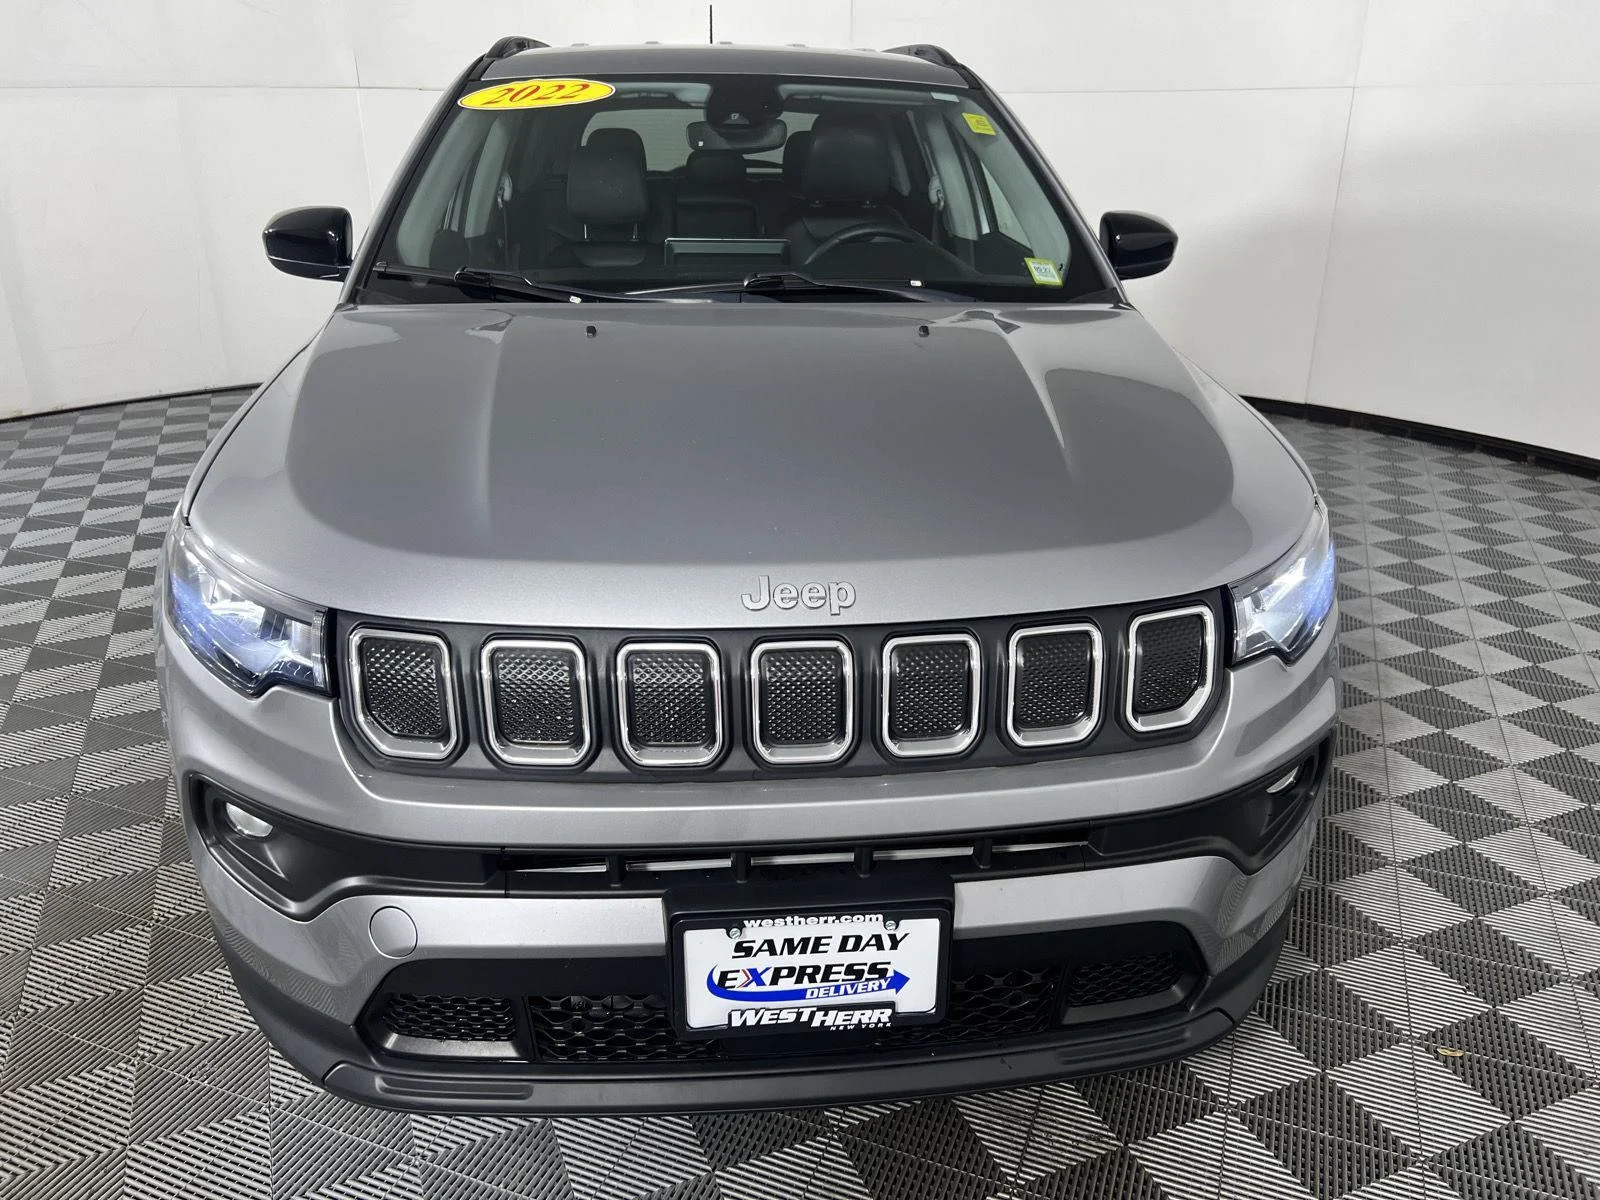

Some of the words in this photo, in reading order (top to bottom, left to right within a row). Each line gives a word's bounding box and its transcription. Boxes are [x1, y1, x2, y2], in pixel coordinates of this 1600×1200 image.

[480, 83, 590, 106] 2022
[740, 575, 856, 616] Jeep
[743, 914, 884, 928] westherr.com
[732, 936, 833, 959] SAME
[838, 933, 909, 953] DAY
[717, 961, 891, 989] EXPRESS
[805, 978, 891, 1000] DELIVERY
